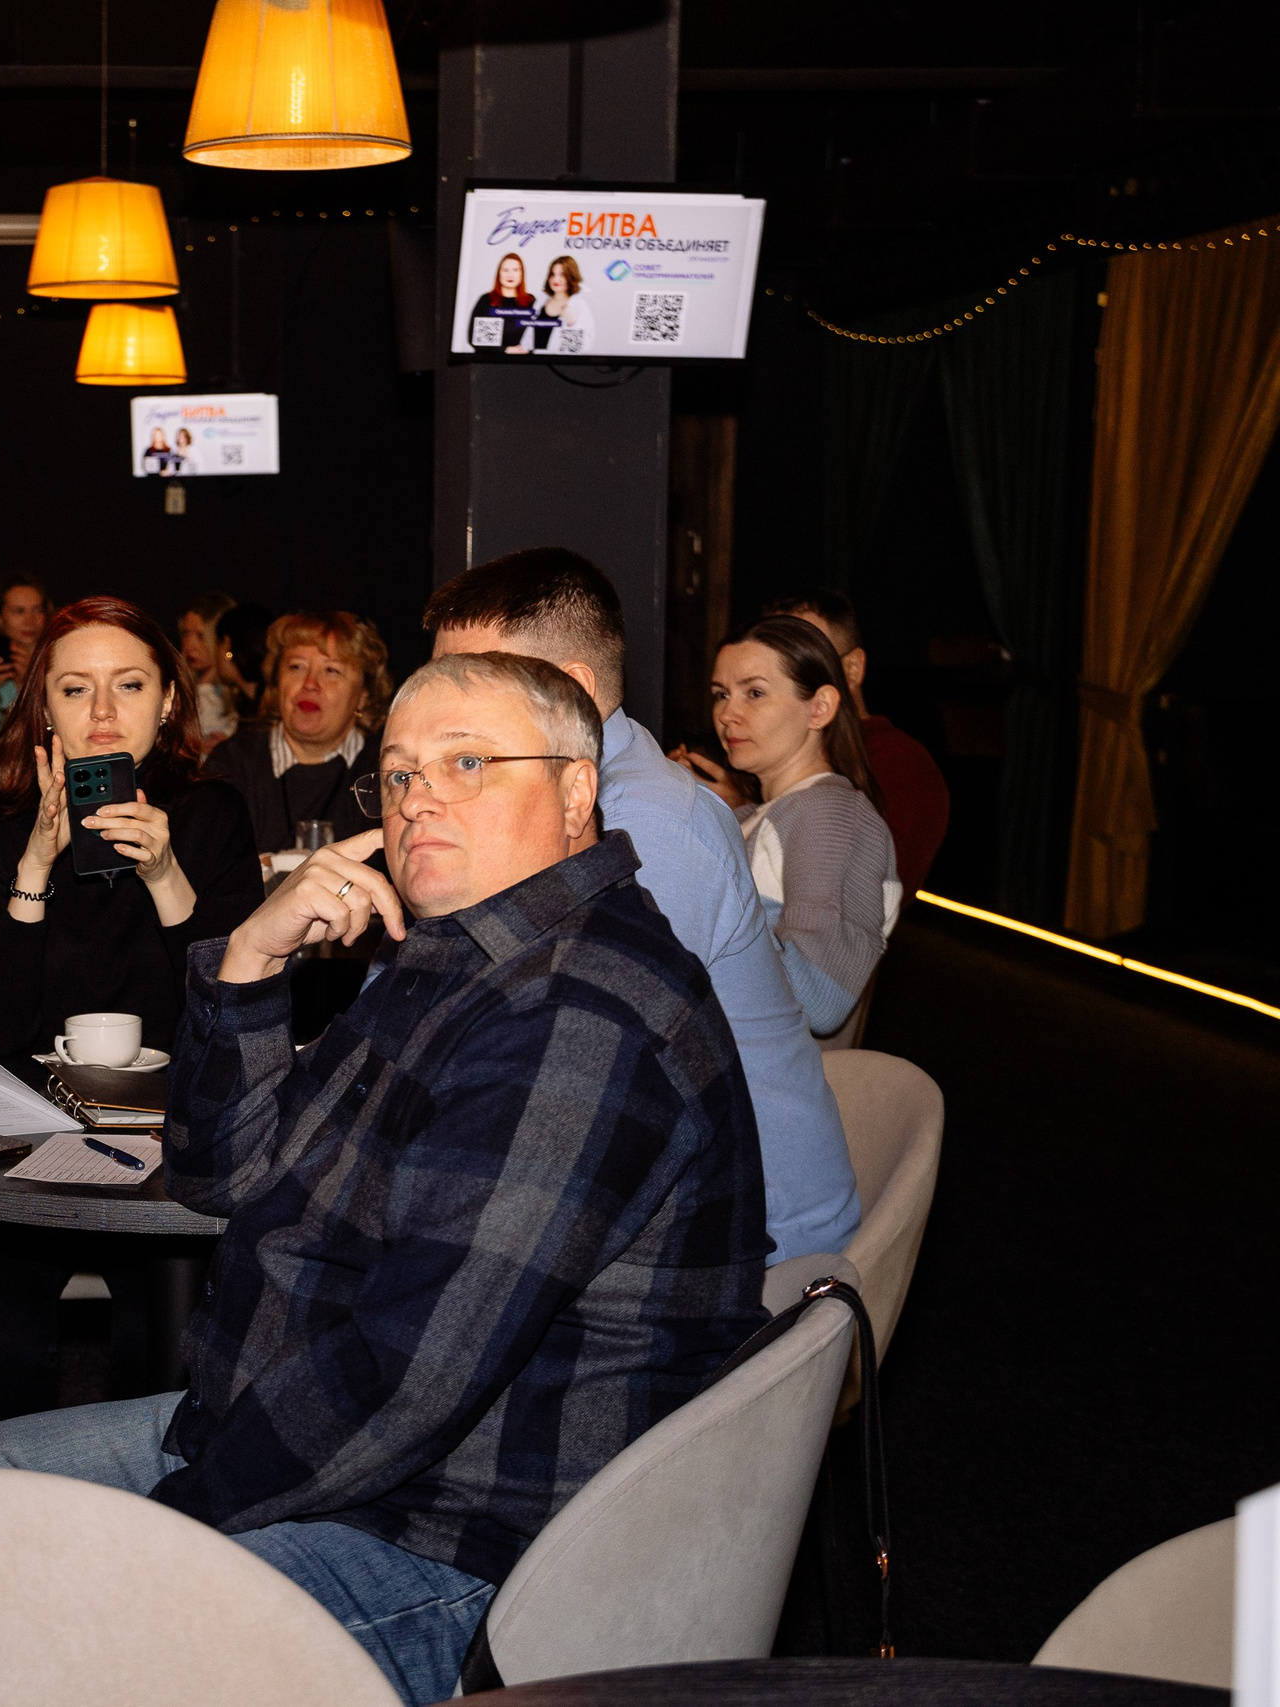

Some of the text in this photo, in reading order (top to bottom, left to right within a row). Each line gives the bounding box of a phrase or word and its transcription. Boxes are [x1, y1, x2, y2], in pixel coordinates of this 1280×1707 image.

[567, 212, 657, 238] БИТВА
[564, 237, 730, 253] КОТОРАЯ ОБЪЕДИНЯЕТ
